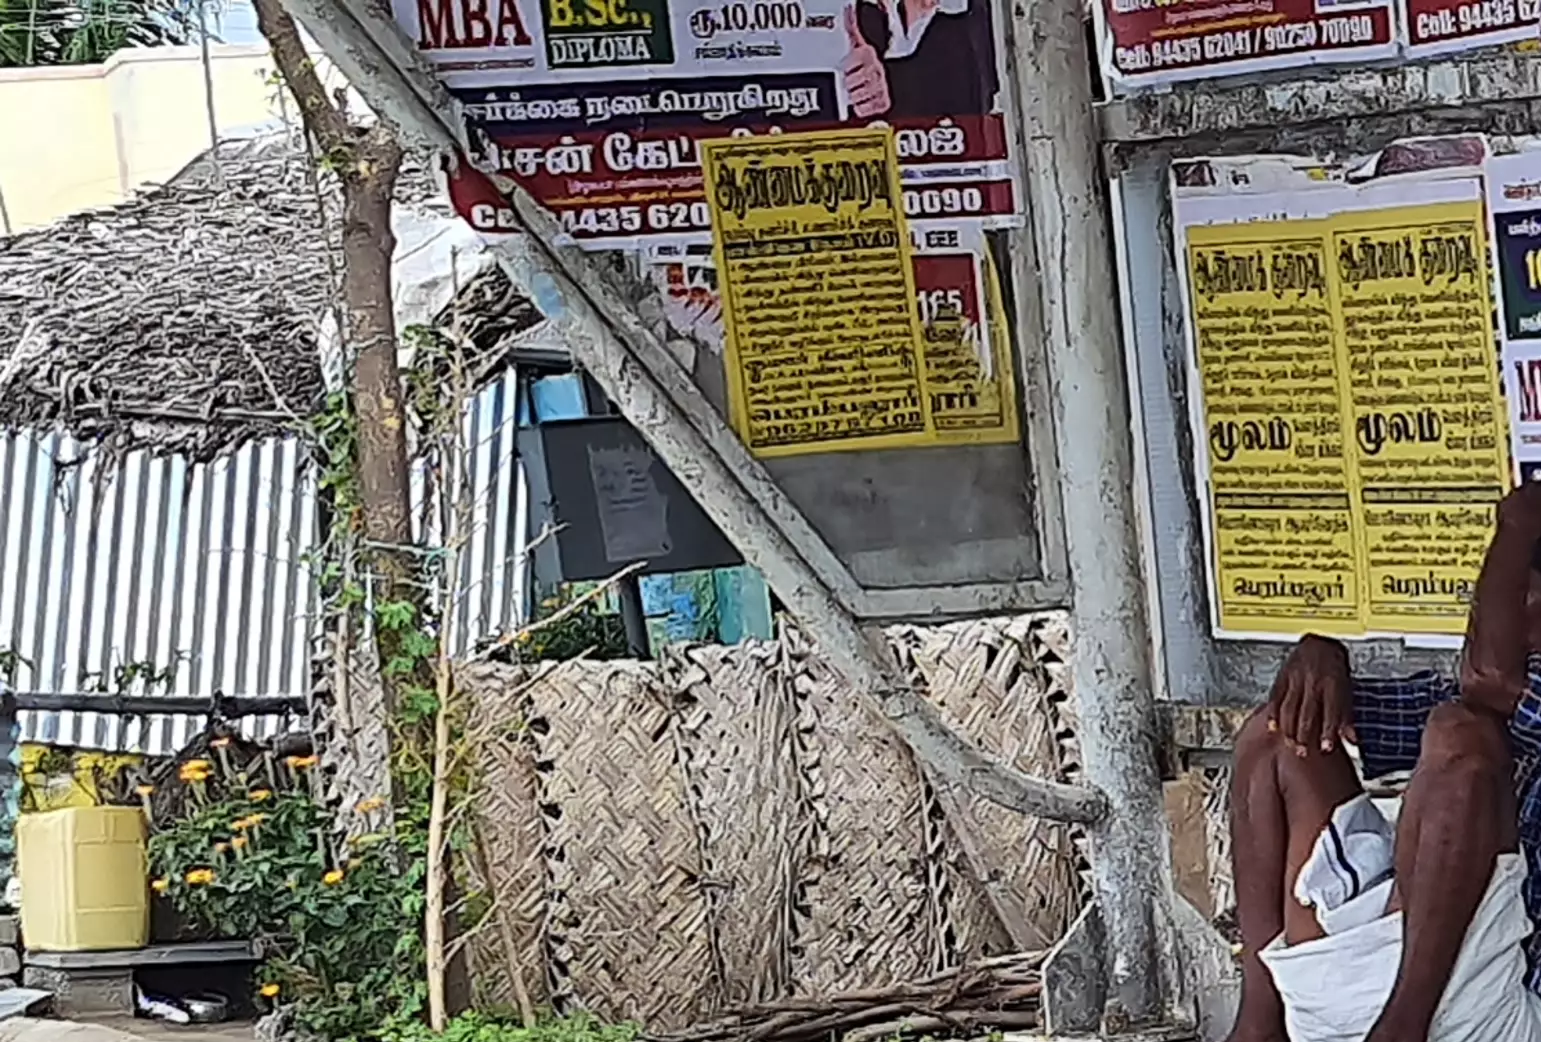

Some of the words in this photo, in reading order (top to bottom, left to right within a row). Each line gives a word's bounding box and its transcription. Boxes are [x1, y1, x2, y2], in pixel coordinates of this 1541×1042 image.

[552, 36, 651, 63] DIPLOMA
[1210, 415, 1294, 462] மூலம்
[1356, 405, 1443, 456] மூலம்
